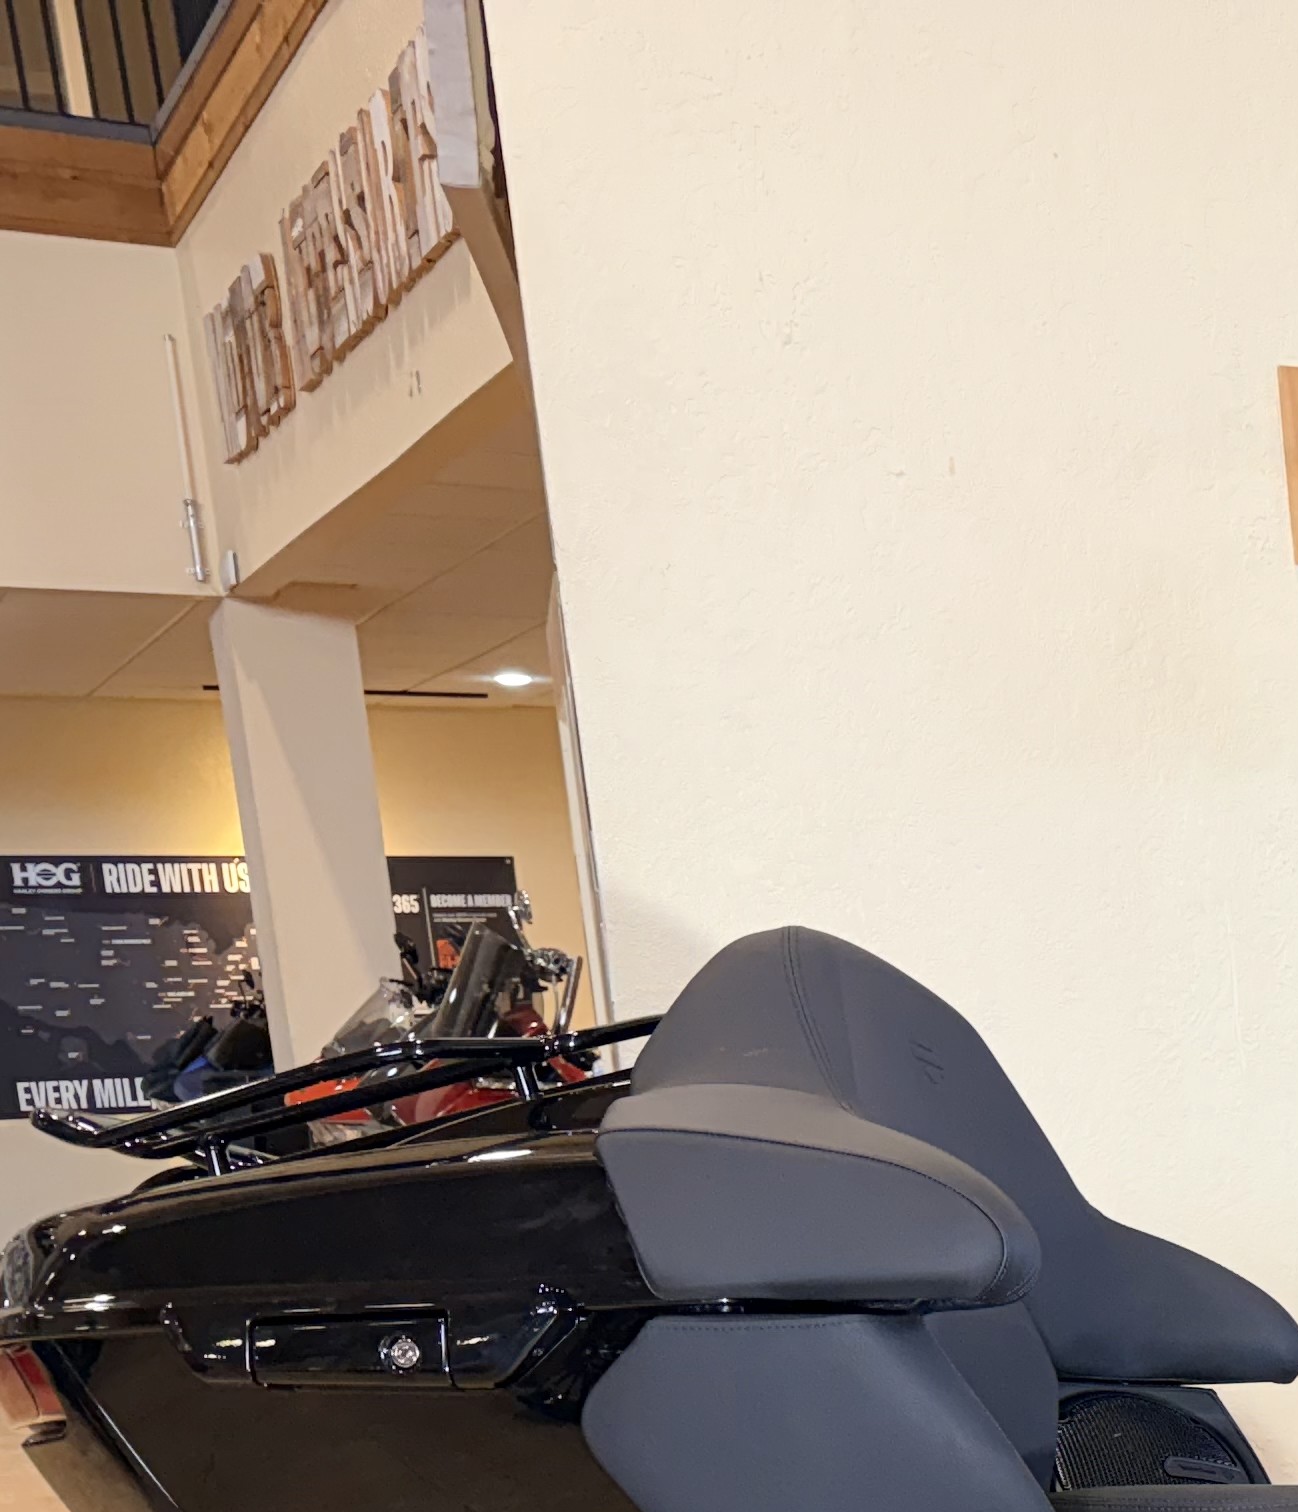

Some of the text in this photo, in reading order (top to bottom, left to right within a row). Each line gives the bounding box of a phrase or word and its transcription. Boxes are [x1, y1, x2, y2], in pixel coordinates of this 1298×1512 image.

[10, 862, 81, 887] HOG
[102, 862, 251, 893] RIDE WITH US
[392, 894, 420, 914] 365
[16, 1079, 89, 1111] EVERY
